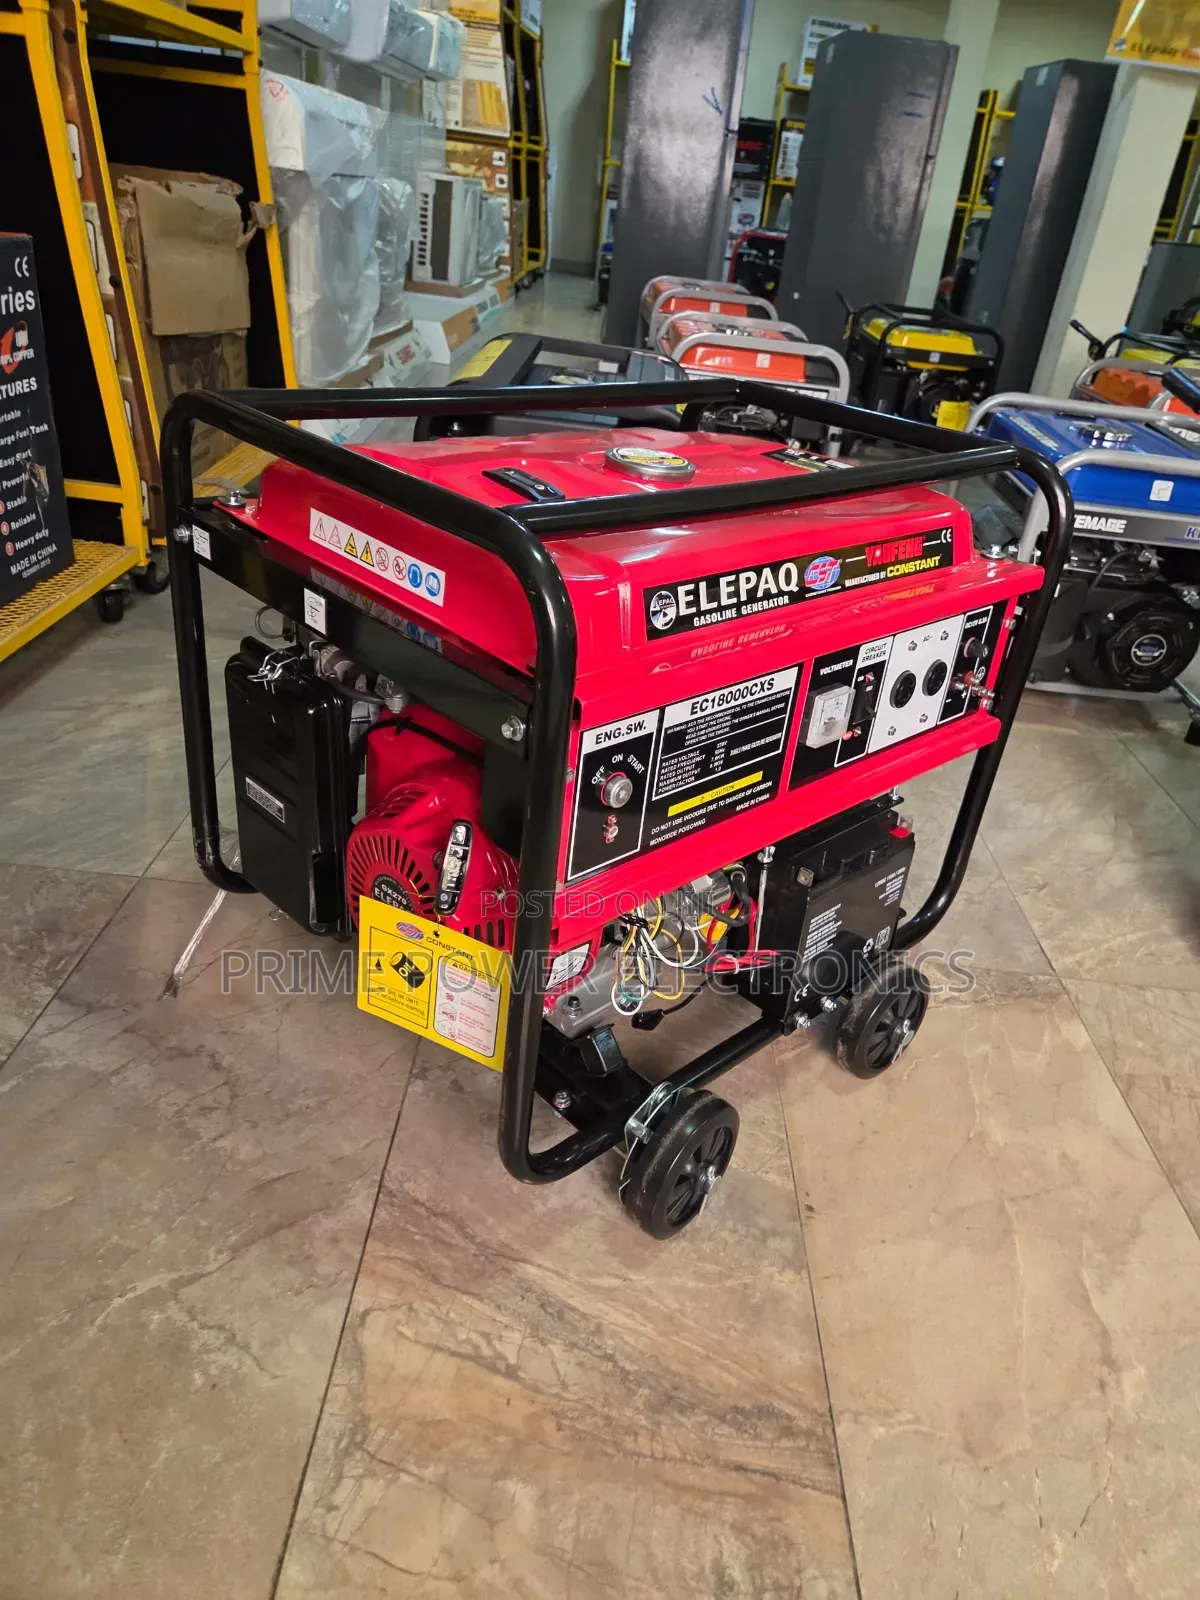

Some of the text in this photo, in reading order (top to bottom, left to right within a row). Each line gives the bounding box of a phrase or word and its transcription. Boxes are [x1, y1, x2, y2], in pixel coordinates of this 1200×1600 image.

[0, 376, 38, 400] TURES
[1073, 513, 1128, 534] EMAGE
[10, 542, 58, 576] MADE IN CHINA
[886, 555, 941, 578] CONSTANT
[677, 561, 800, 617] ELEPAQ
[693, 595, 789, 628] GASOLINE GENERATOR
[861, 650, 887, 663] BREAKER
[865, 642, 888, 655] CIRCUIT
[819, 659, 854, 676] VOLTMETER
[689, 677, 775, 717] EC18000CXS
[594, 719, 647, 746] ENG.SW.
[591, 752, 645, 785] OFF ON START
[660, 764, 678, 775] RATED
[677, 754, 706, 769] FREQUENCY
[661, 757, 679, 768] RATED
[679, 750, 700, 762] VOLTAGE
[658, 775, 682, 788] MAXIMUM
[682, 767, 702, 779] OUTPUT
[659, 771, 676, 781] RATED
[676, 763, 696, 775] OUTPUT
[657, 783, 676, 794] POWER
[675, 775, 695, 788] FACTOR
[651, 826, 660, 835] DO
[660, 821, 672, 831] NOT
[672, 816, 683, 826] USE
[683, 808, 707, 821] INDOORS
[706, 803, 718, 813] DUE
[725, 791, 746, 805] DANGER
[745, 788, 753, 796] OF
[752, 780, 773, 793] CARBON
[735, 801, 751, 812] MADE
[755, 792, 770, 804] CHINA
[649, 818, 706, 847] MONOXIDE POISONING
[426, 936, 477, 960] CONSTANT
[398, 961, 416, 977] OIL
